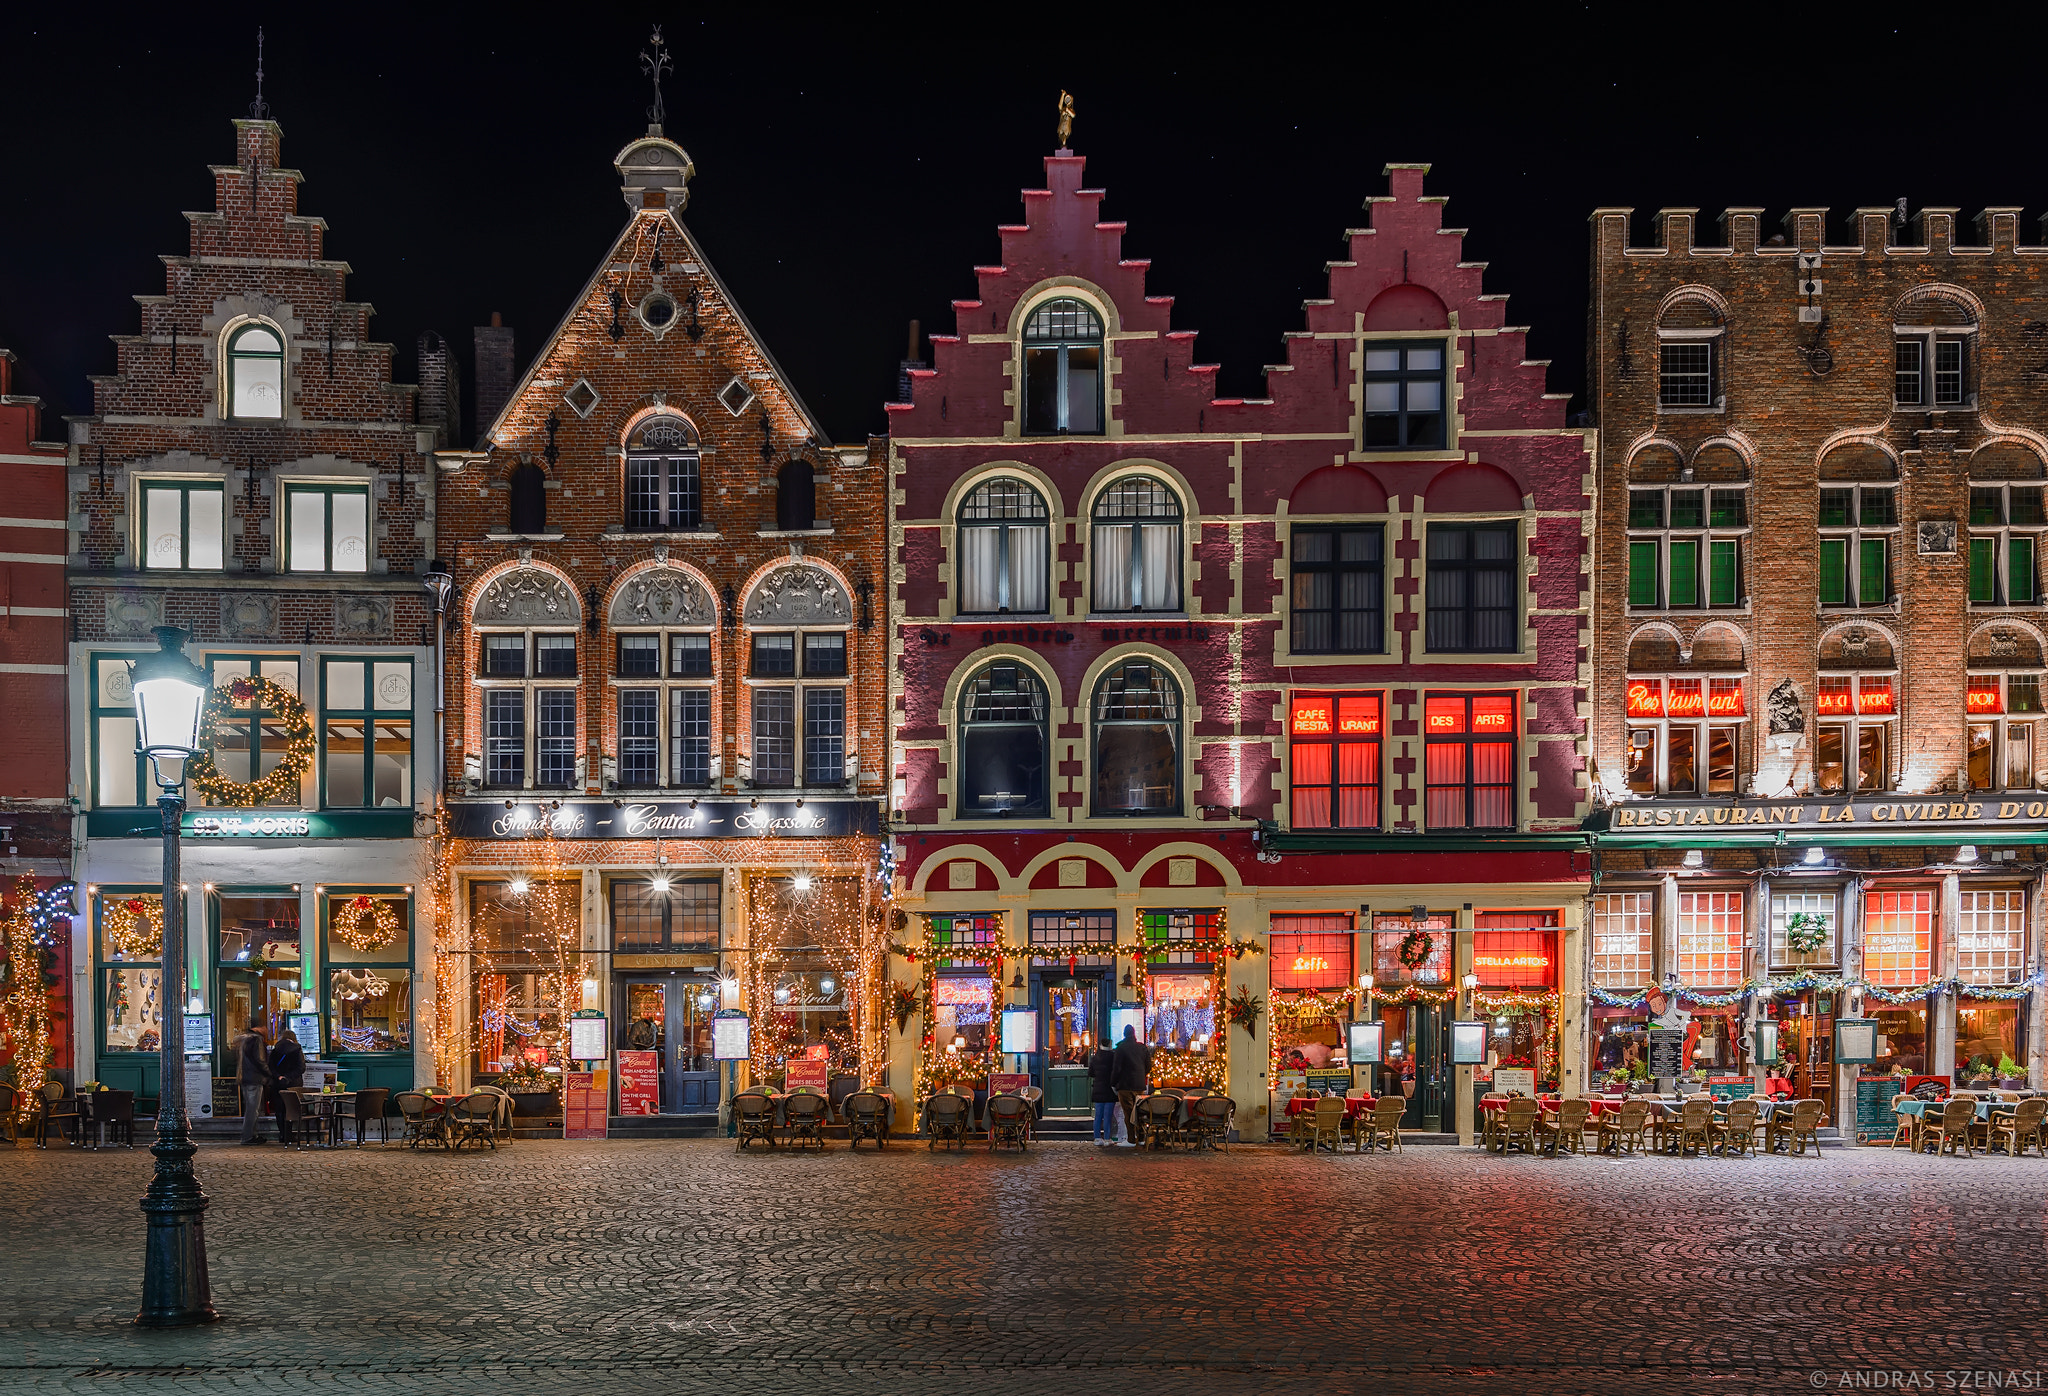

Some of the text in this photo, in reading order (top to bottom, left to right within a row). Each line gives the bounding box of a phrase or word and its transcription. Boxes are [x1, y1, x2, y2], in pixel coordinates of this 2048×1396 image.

[1819, 695, 1832, 708] LA
[1297, 710, 1326, 720] CAFE
[1431, 715, 1505, 726] DES ARTS
[624, 804, 697, 836] Central
[1618, 806, 1804, 826] RESTAURANT
[1818, 805, 1855, 823] LA
[193, 817, 309, 836] SINT JORIS
[1293, 957, 1328, 972] Leffe
[1475, 957, 1511, 966] STELLA
[938, 984, 989, 1004] Pasta
[1156, 981, 1203, 998] Pizza
